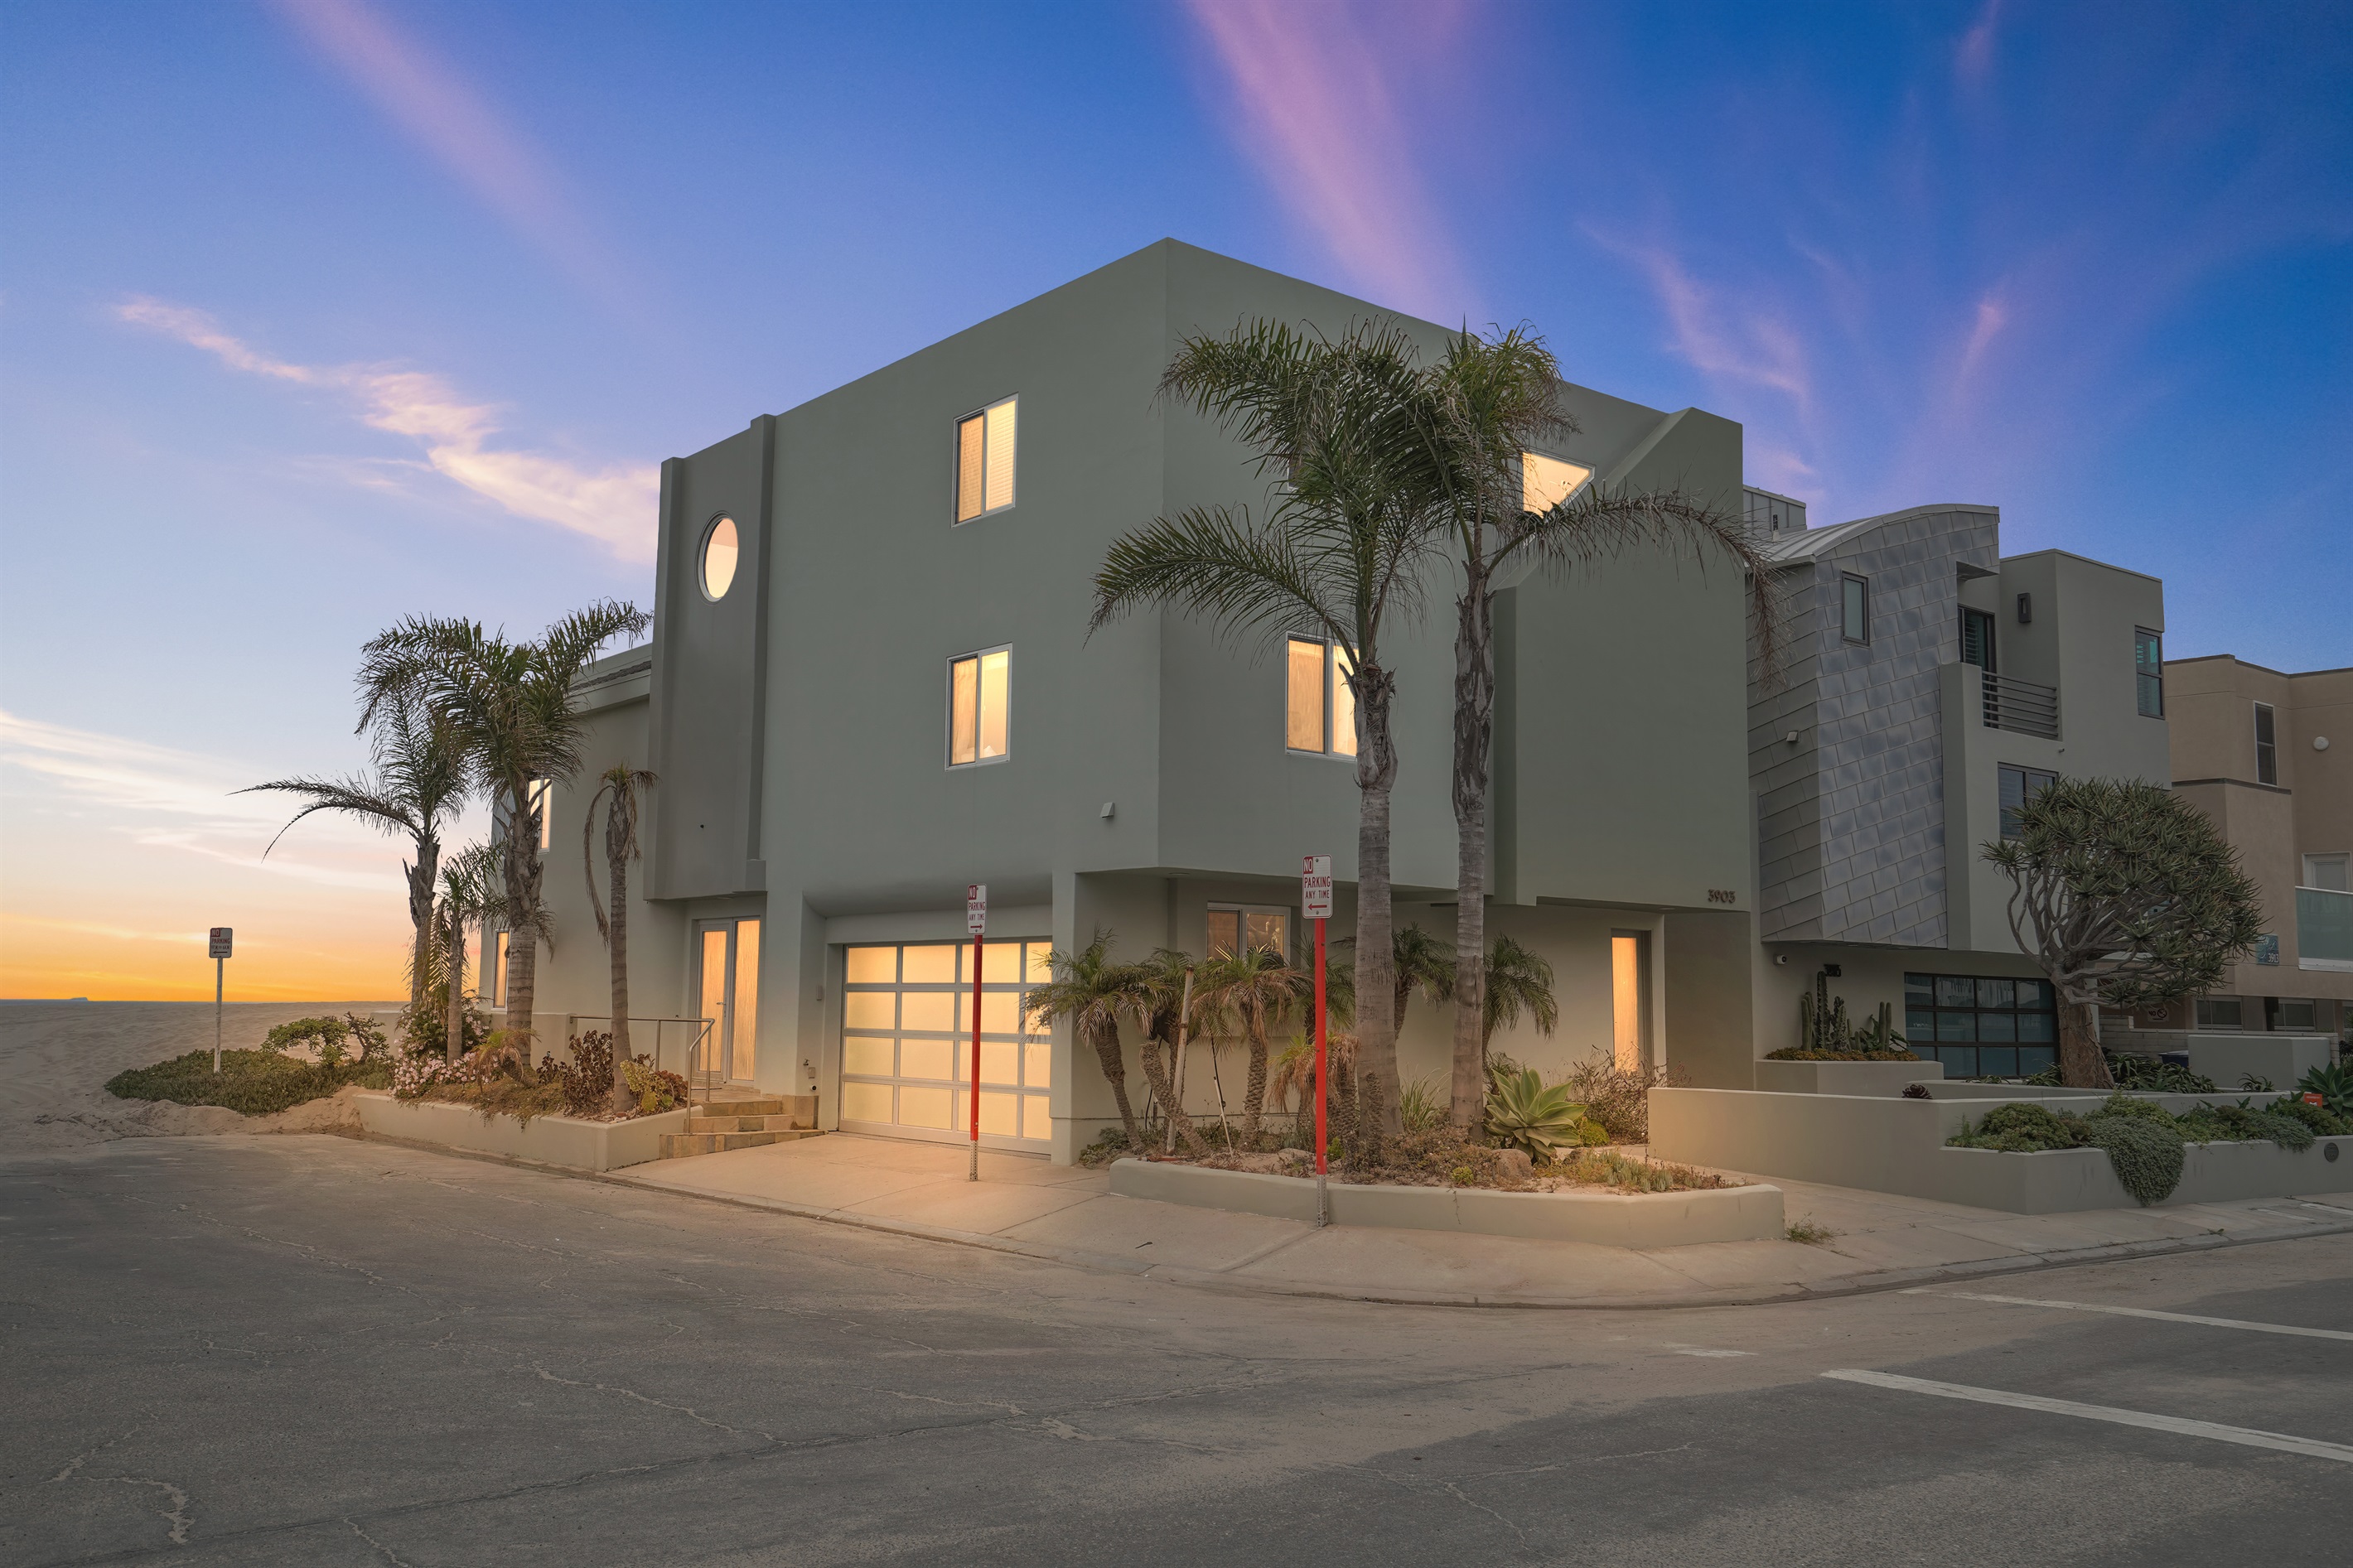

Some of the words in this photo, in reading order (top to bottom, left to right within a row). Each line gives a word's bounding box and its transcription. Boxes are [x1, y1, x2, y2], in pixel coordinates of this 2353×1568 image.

[1304, 858, 1312, 872] NO
[1304, 876, 1331, 889] PARKING
[969, 886, 976, 898] NO
[1305, 890, 1316, 900] ANY
[1318, 890, 1330, 899] TIME
[1708, 889, 1737, 904] 3903
[969, 901, 986, 911] PARKING
[977, 913, 985, 921] TIME
[211, 929, 220, 937] NO
[2268, 953, 2279, 963] 3913
